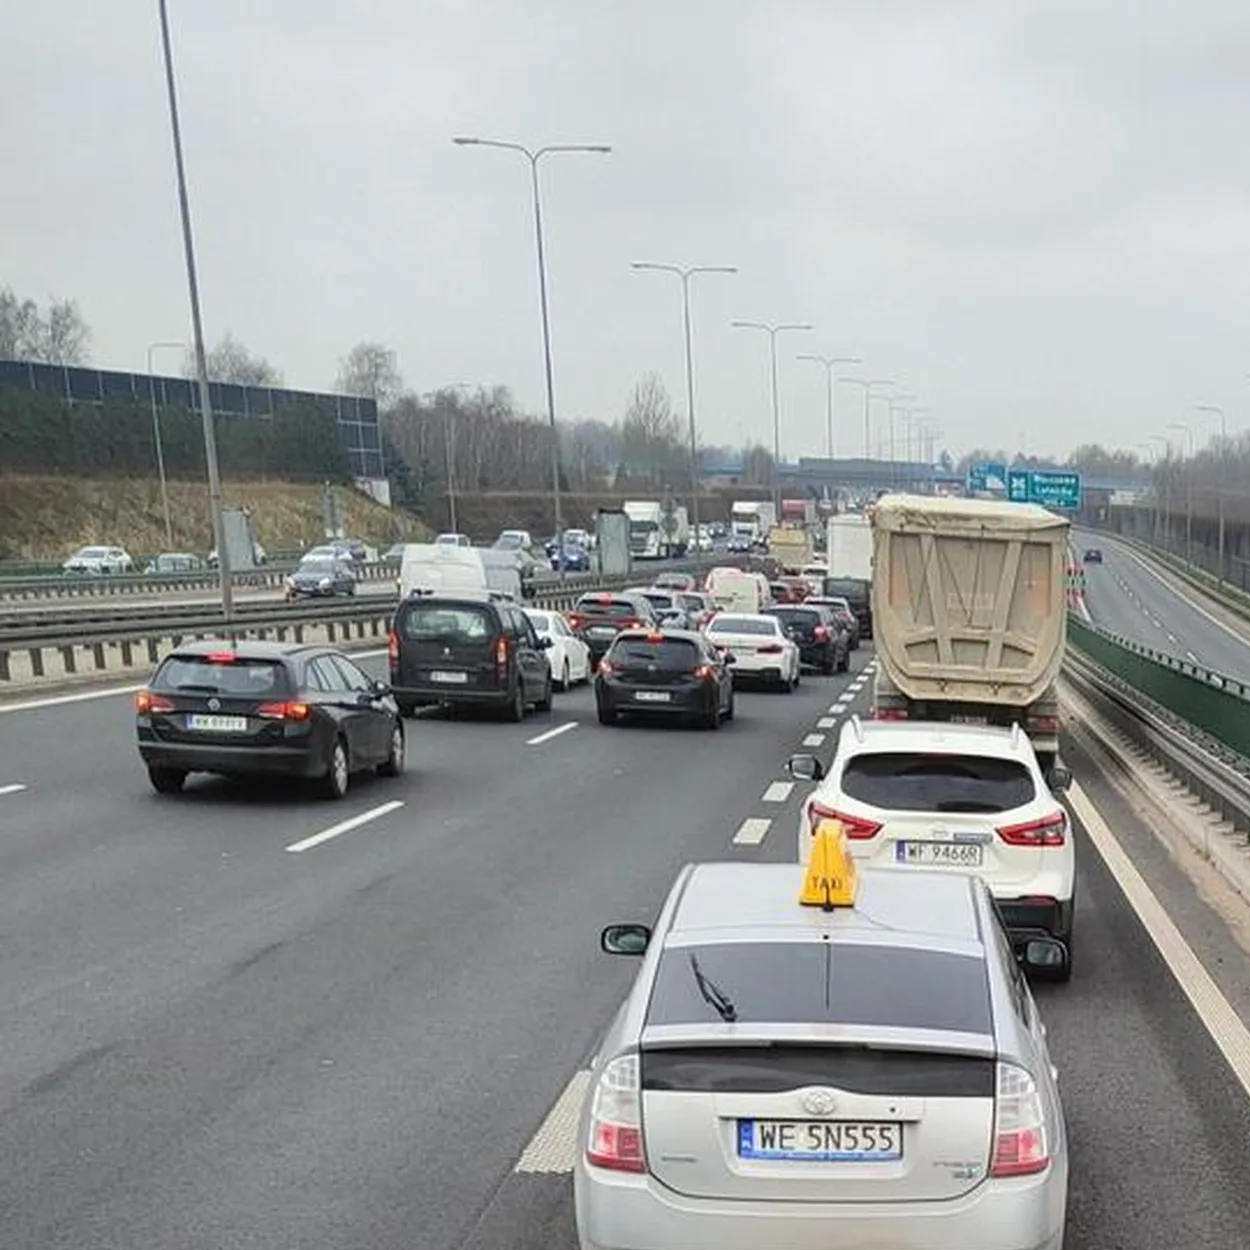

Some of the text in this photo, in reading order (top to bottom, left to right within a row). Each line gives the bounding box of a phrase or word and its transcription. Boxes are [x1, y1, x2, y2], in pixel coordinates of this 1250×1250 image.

[811, 875, 843, 890] TAXI
[759, 1123, 894, 1152] WE 5N555
